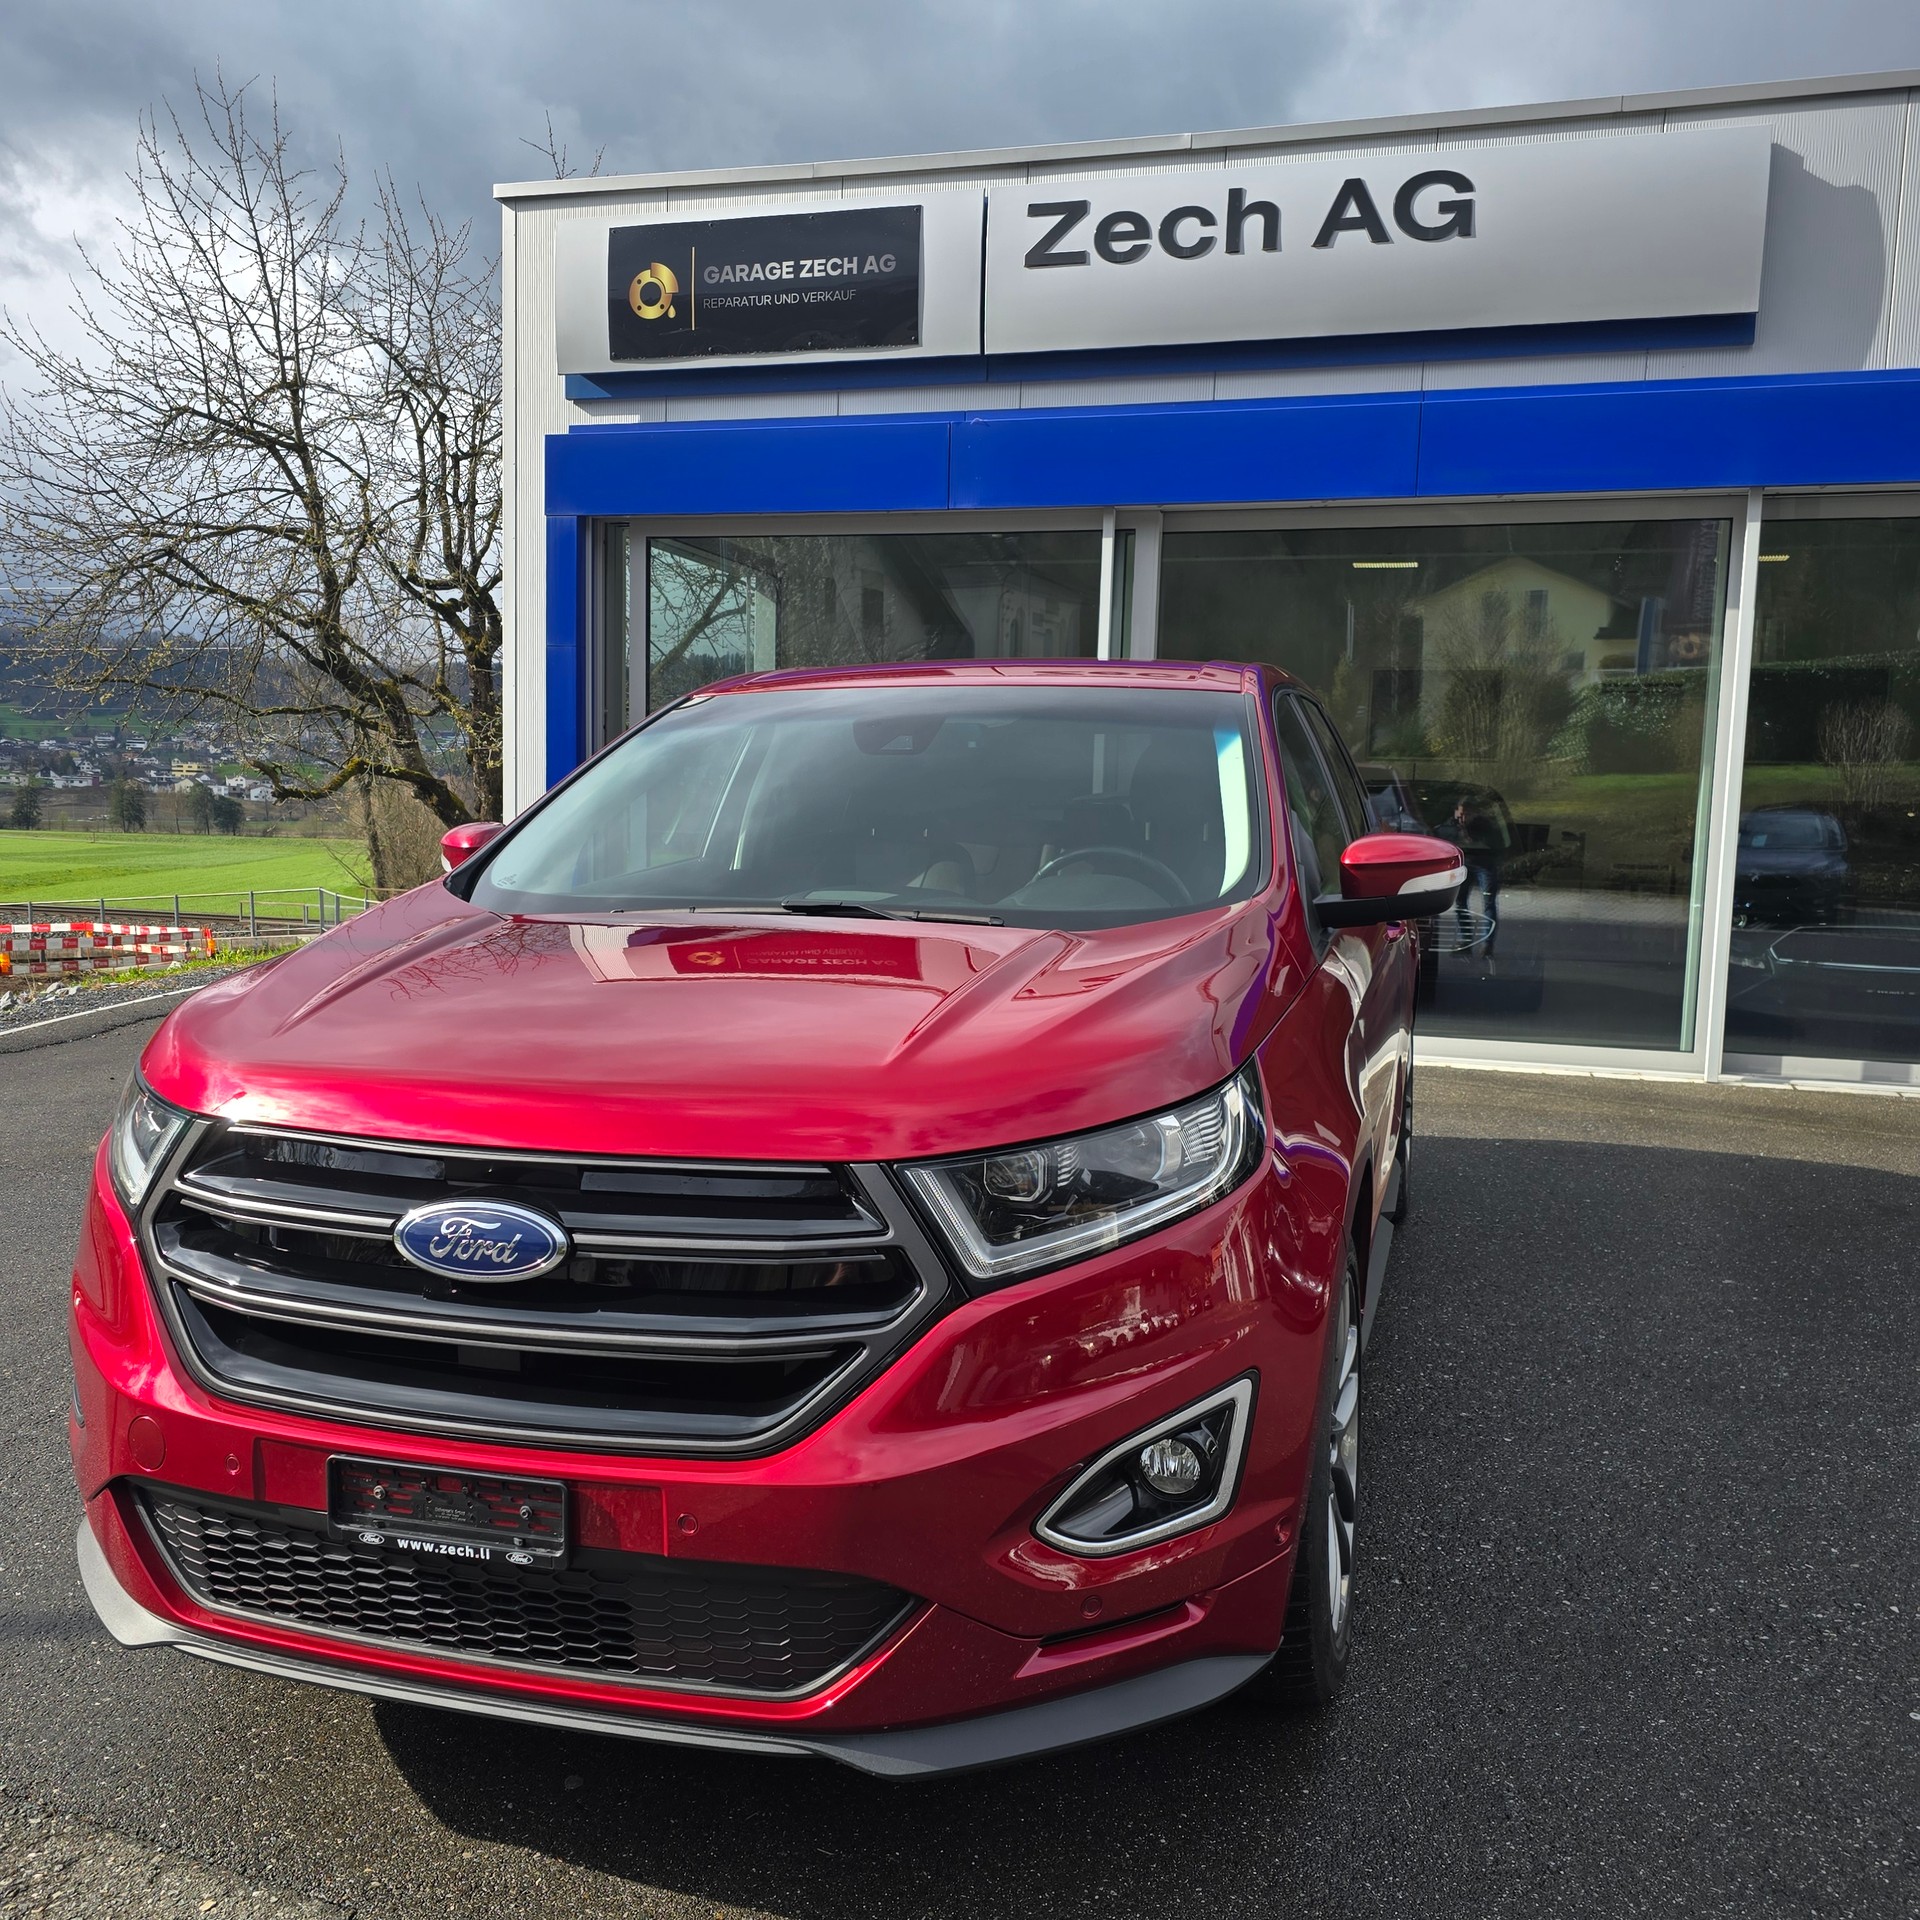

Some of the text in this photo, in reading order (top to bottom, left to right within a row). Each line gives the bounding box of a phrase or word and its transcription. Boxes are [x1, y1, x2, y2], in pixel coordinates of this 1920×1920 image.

[1023, 168, 1477, 269] Zech AG
[703, 253, 897, 285] GARAGE ZECH AG
[702, 289, 857, 309] REPARATUR UND VERKAUF
[429, 1216, 523, 1264] Ford
